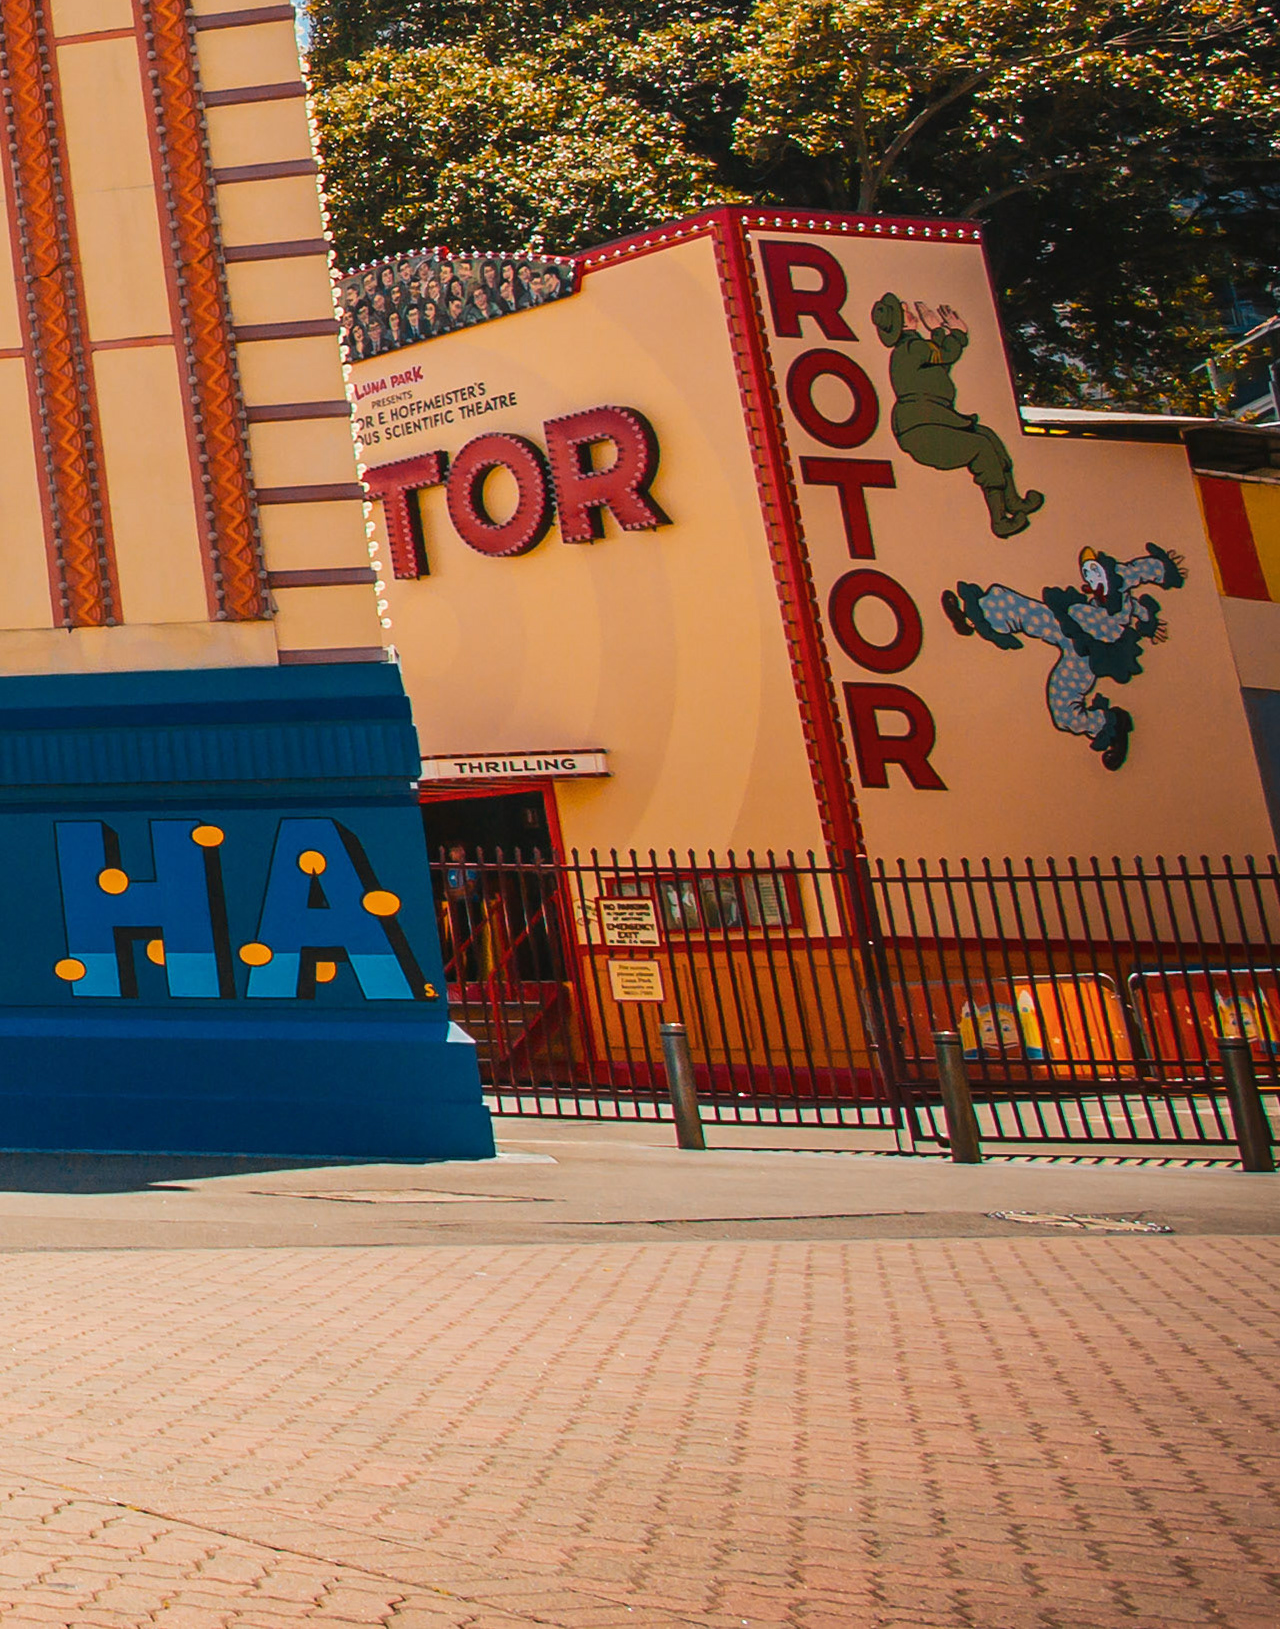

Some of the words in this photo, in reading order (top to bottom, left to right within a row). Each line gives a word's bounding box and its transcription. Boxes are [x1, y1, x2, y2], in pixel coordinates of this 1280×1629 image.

[354, 379, 387, 400] LUNA
[390, 366, 424, 388] PARK
[354, 416, 375, 431] OR
[378, 412, 387, 424] E
[390, 382, 486, 421] HOFFMEISTER'S
[371, 390, 413, 409] PRESENTS
[385, 410, 454, 440] SCIENTIFIC
[458, 392, 518, 419] THEATRE
[363, 406, 672, 581] TOR
[758, 239, 949, 791] ROTOR
[454, 758, 576, 774] THRILLING
[53, 817, 438, 1000] HA
